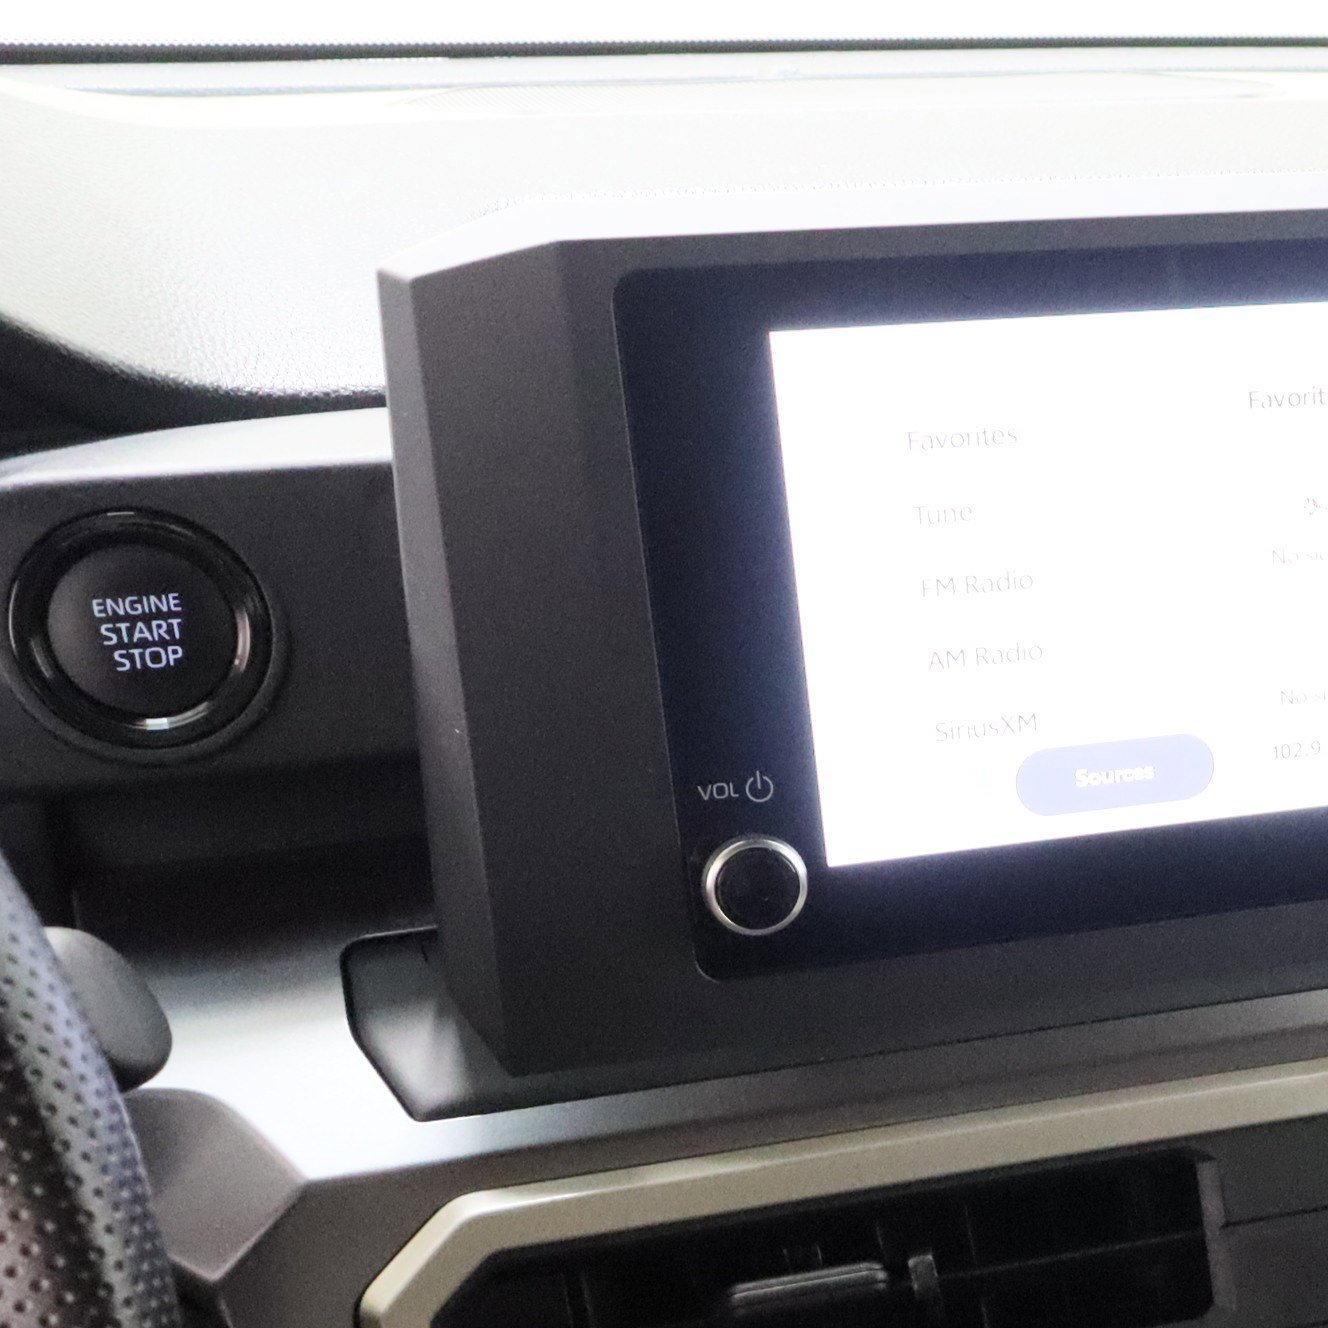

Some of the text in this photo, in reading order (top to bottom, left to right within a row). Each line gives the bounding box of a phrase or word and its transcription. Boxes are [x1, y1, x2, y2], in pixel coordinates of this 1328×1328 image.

[906, 425, 1018, 452] Favorites
[913, 504, 974, 526] Tune
[920, 569, 1034, 598] FM Radio
[91, 592, 183, 618] ENGINE
[99, 617, 183, 646] START
[114, 643, 184, 672] STOP
[928, 641, 1044, 671] AM Radio
[934, 711, 1039, 743] SiriusXM
[1273, 739, 1322, 760] 102.9
[1075, 764, 1155, 788] Sources
[696, 781, 739, 802] VOL
